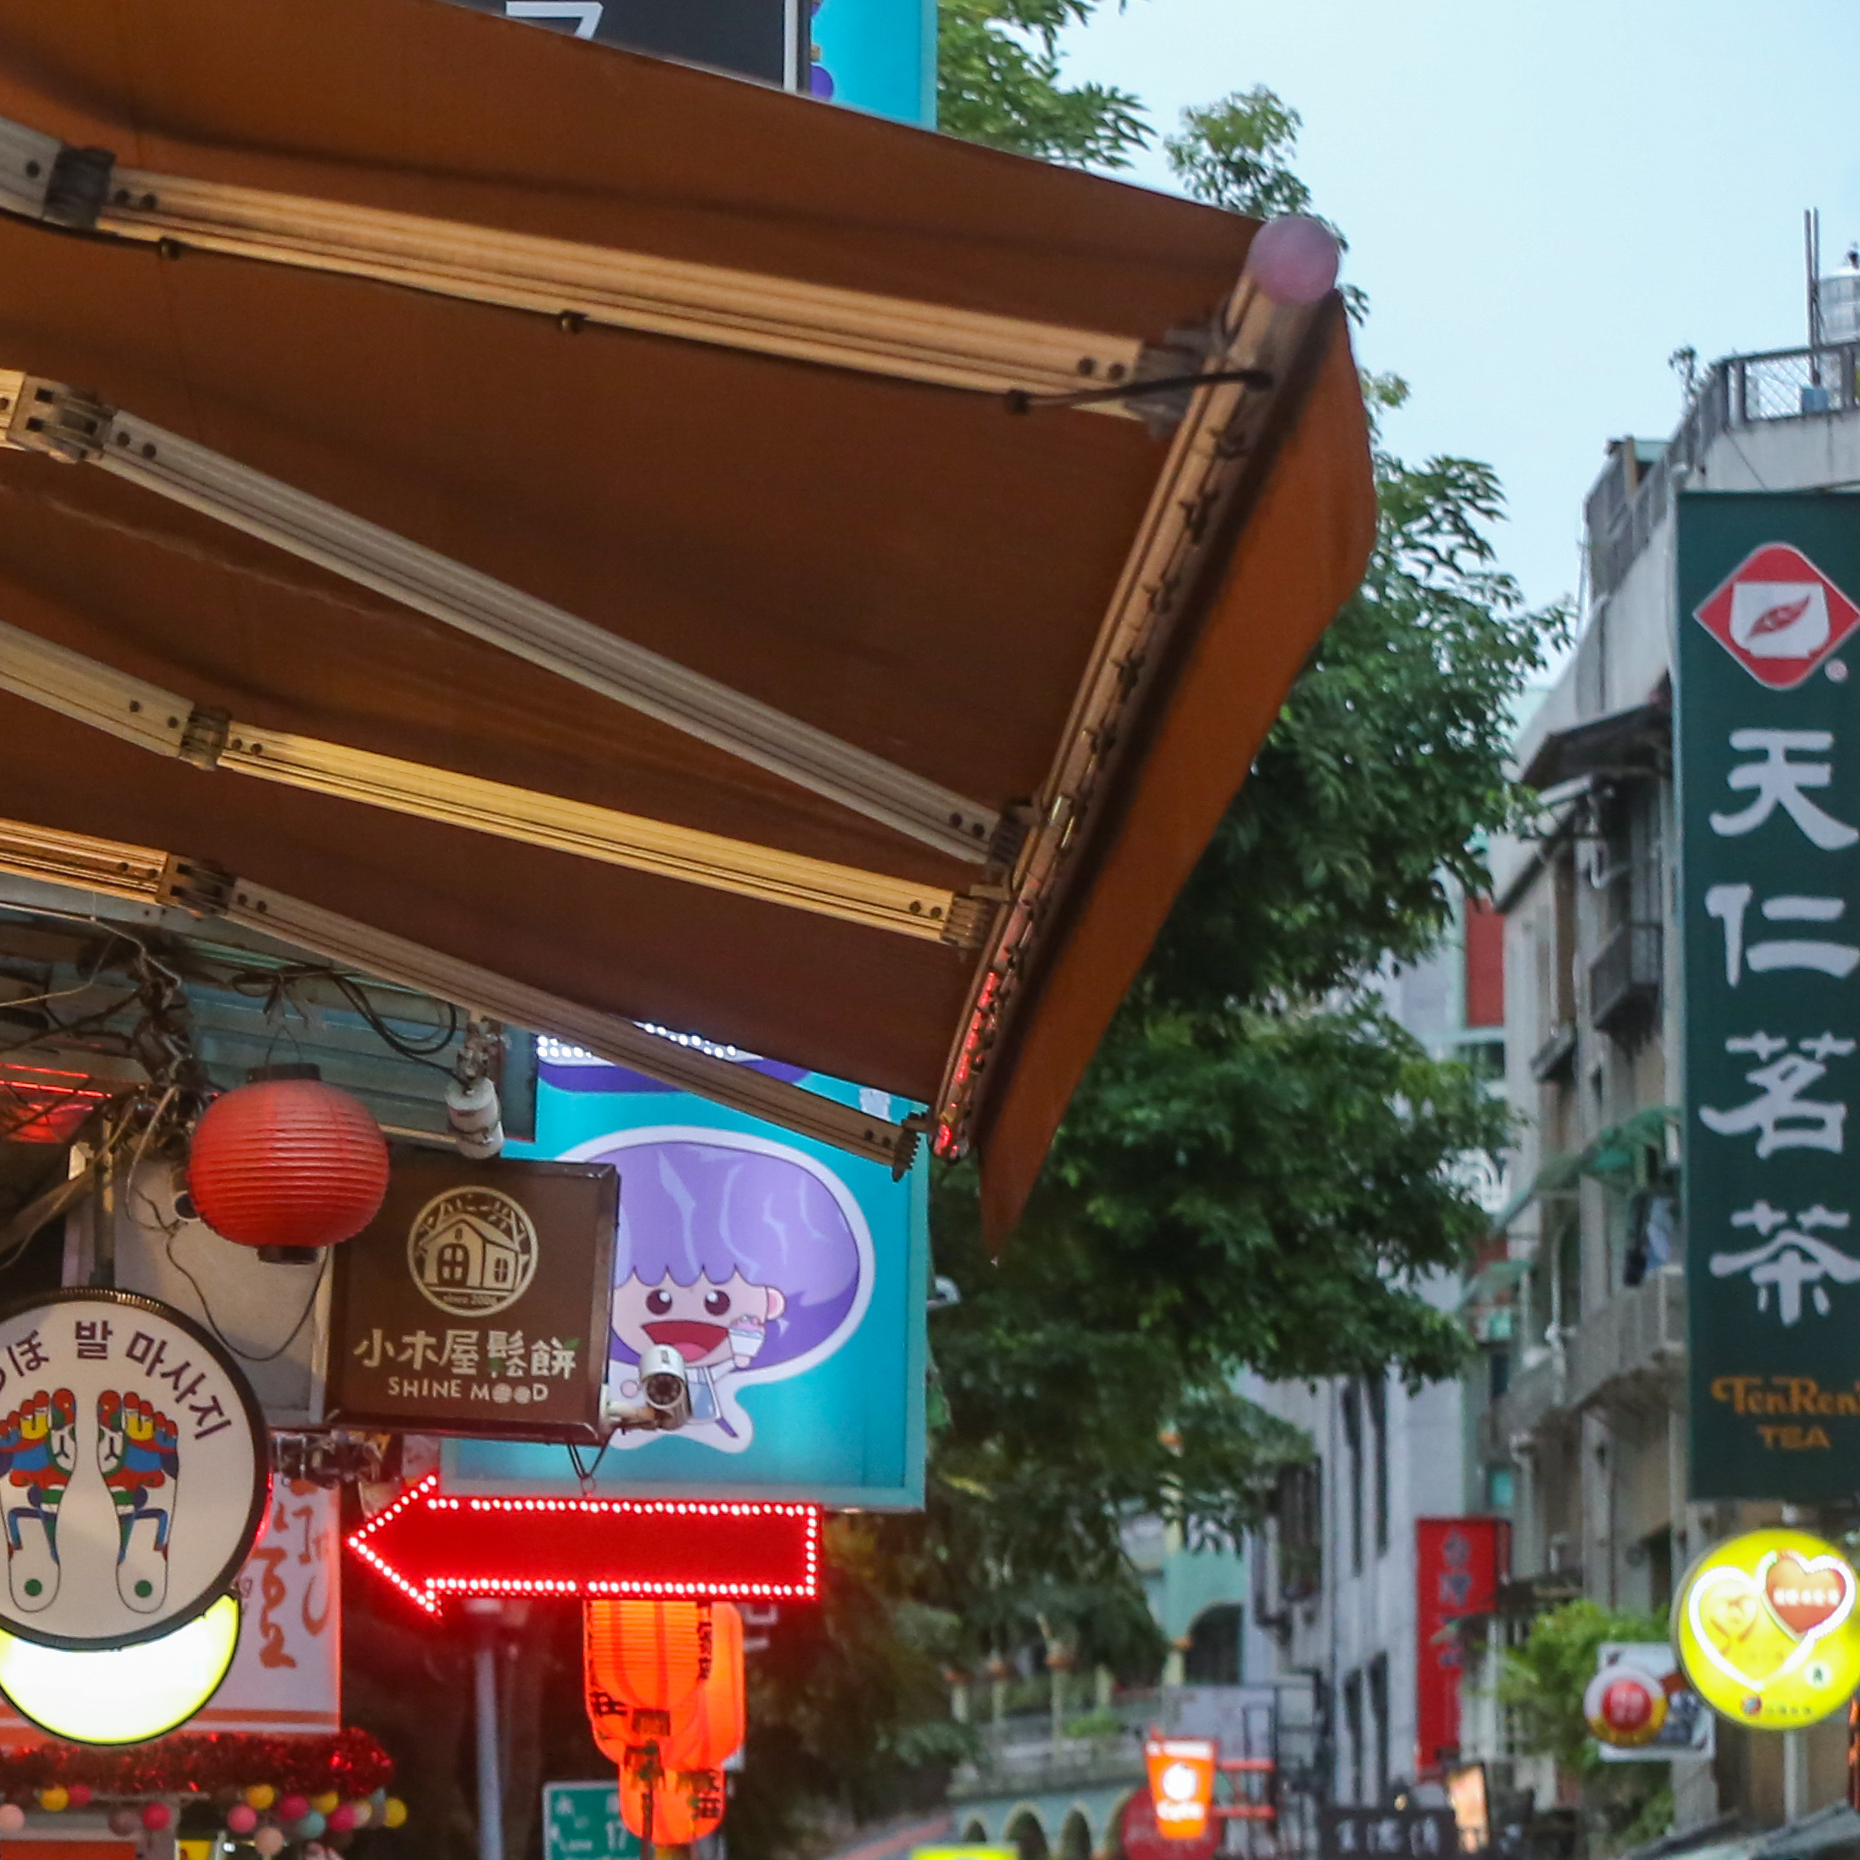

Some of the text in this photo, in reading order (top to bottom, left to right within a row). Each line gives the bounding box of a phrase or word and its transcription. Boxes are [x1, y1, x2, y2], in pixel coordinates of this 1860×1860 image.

[1697, 727, 1860, 1327] 天仁茗茶
[74, 1319, 234, 1443] 발 마사지
[353, 1328, 578, 1381] 小木屋鬆餅
[387, 1375, 463, 1400] SHINE
[1756, 1425, 1833, 1450] TEA
